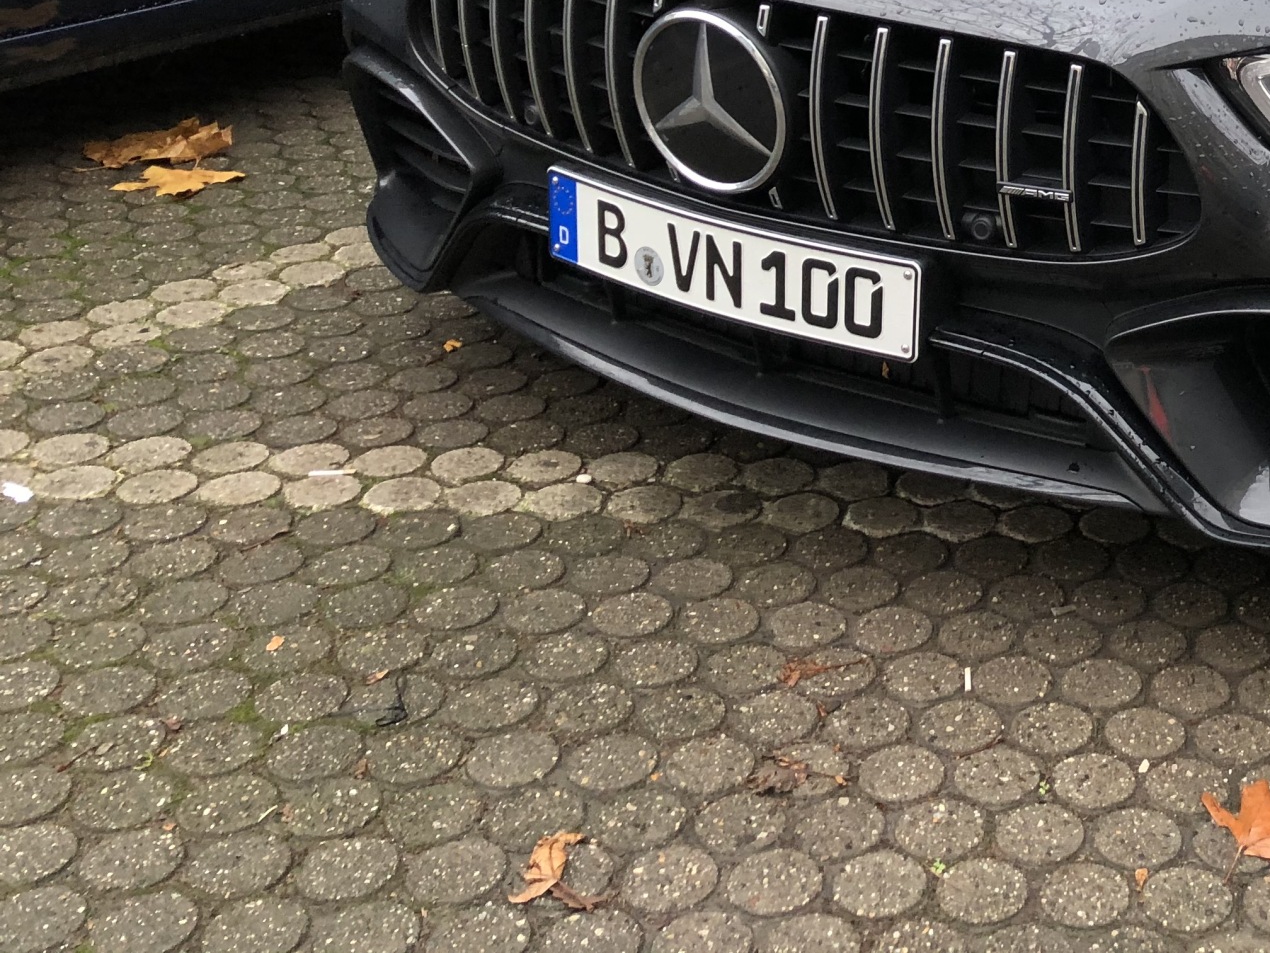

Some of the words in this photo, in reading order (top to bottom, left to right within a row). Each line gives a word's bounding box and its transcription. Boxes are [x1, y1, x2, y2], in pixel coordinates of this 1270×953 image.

[1020, 188, 1070, 202] AMG
[559, 225, 569, 245] D
[597, 198, 628, 268] B
[666, 222, 742, 308] VN
[759, 250, 884, 339] 100
